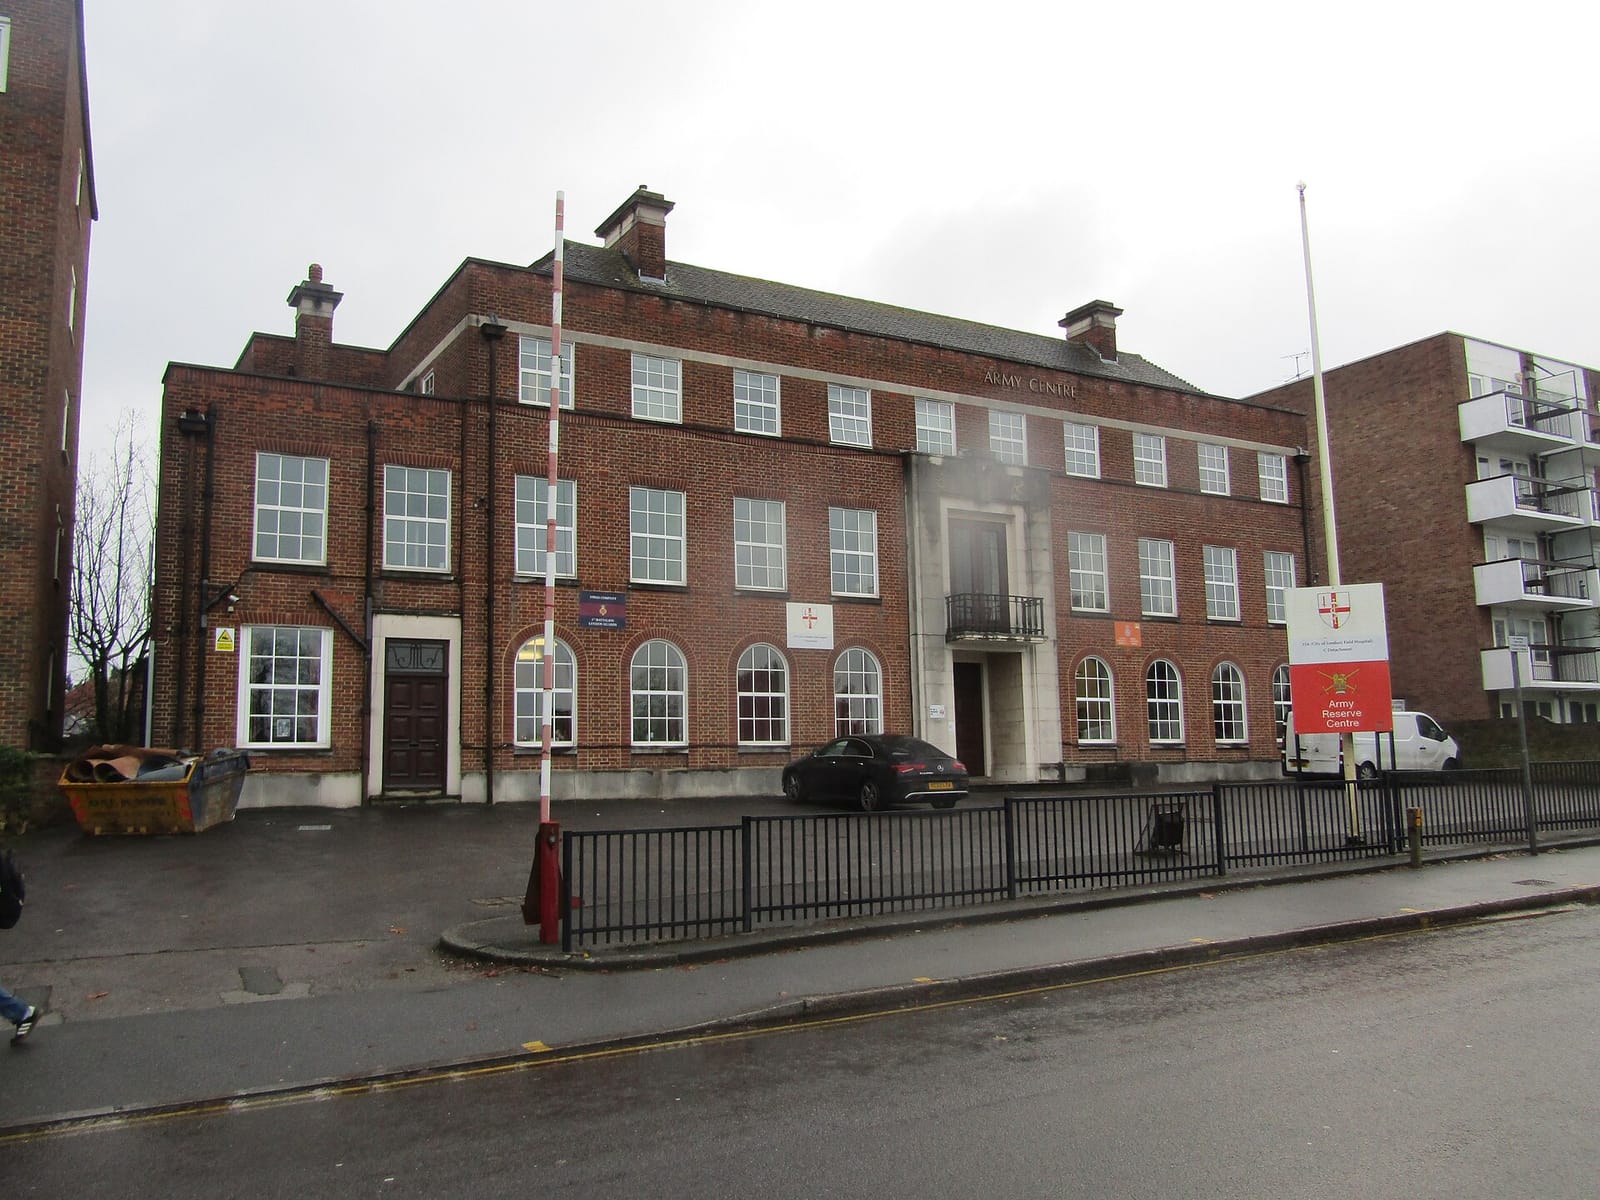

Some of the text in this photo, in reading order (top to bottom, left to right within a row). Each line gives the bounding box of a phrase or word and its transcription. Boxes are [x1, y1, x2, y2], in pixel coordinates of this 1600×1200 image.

[984, 371, 1077, 398] ARMY CENTRE
[1328, 699, 1355, 709] Army
[1322, 709, 1363, 718] Reserve
[1326, 719, 1360, 728] Centre
